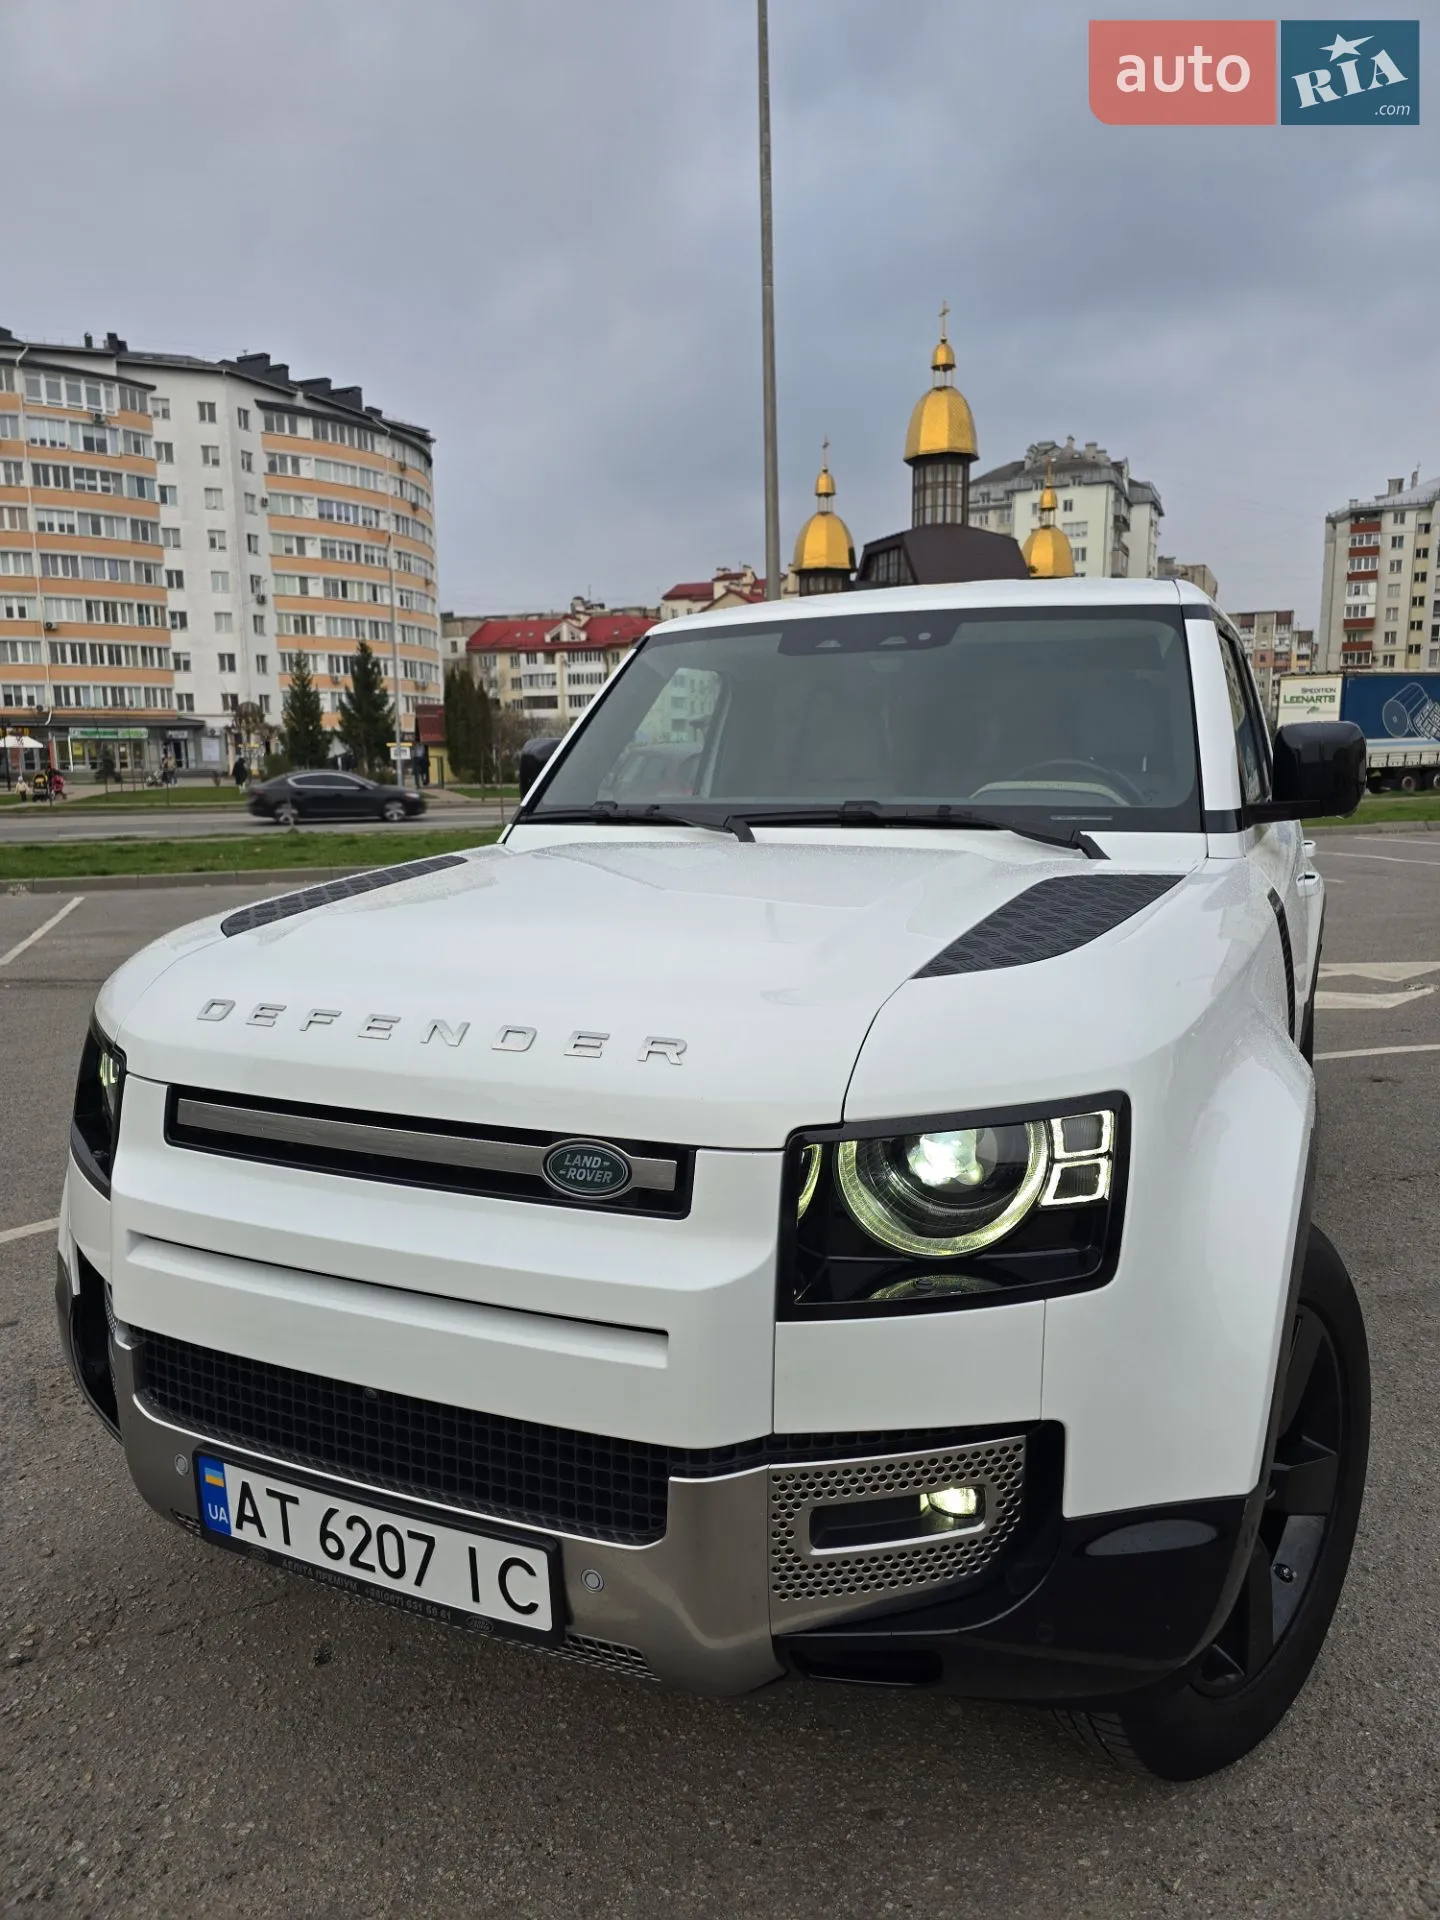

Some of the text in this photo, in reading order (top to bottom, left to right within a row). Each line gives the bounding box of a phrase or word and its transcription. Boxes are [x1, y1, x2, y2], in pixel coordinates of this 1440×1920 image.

[1283, 695, 1336, 704] LEENARTS
[196, 998, 689, 1066] DEFENDER
[208, 1503, 229, 1525] UA
[234, 1480, 540, 1616] AT 6207 IC
